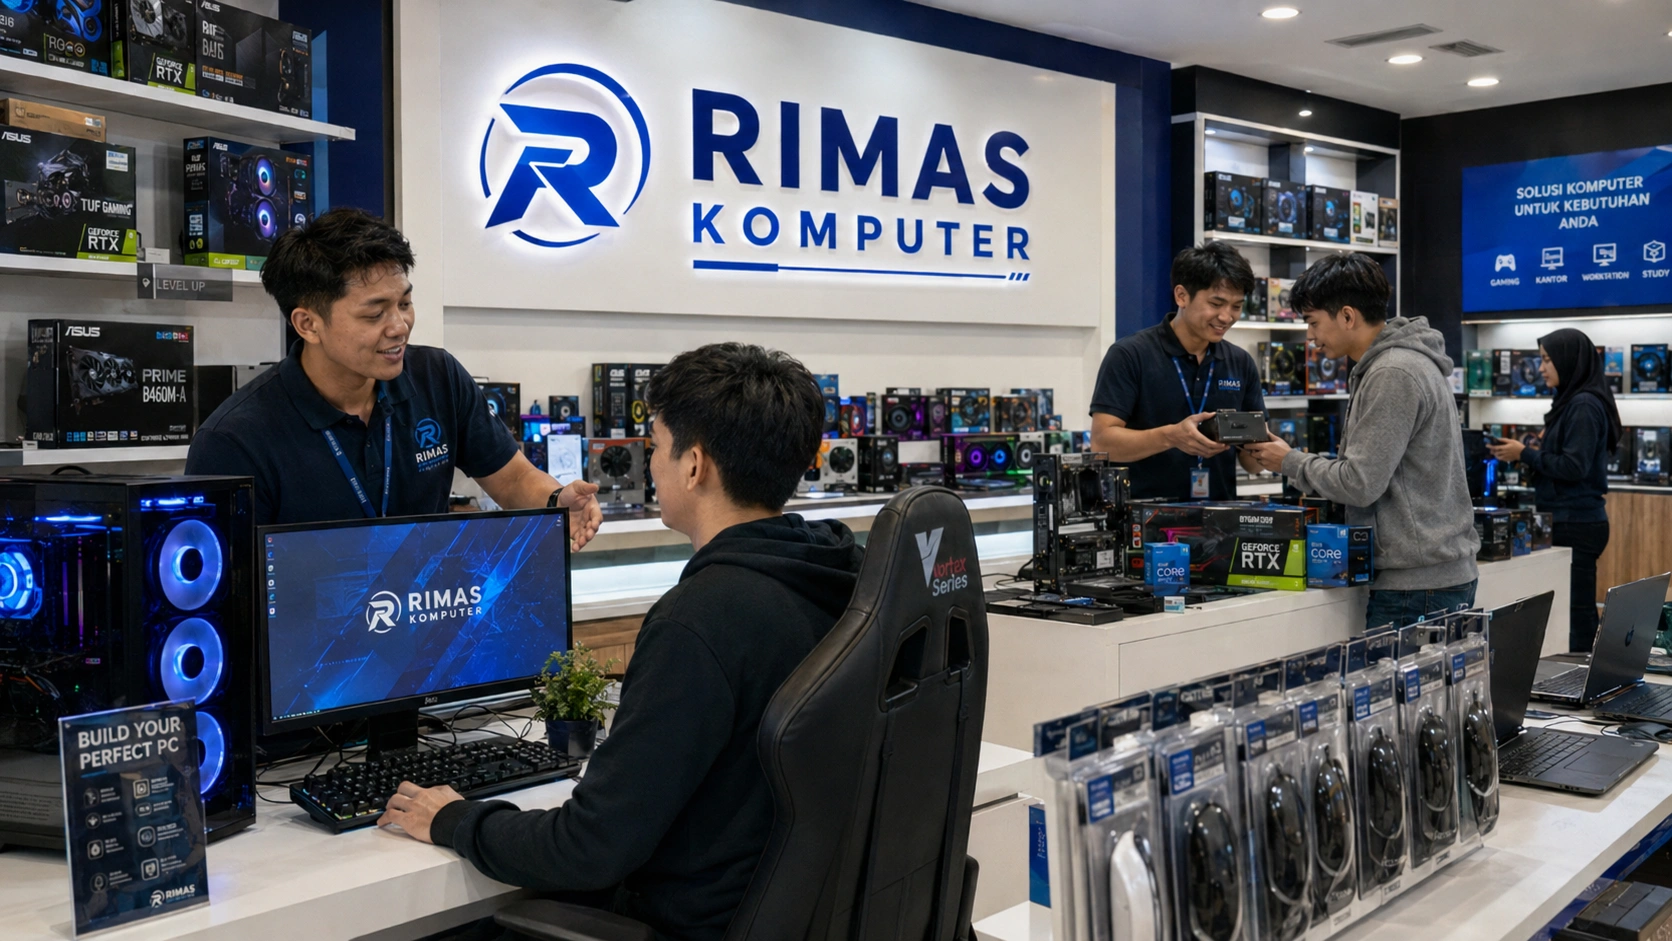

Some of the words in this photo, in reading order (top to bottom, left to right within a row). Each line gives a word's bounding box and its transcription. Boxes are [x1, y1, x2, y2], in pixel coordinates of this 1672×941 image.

[156, 66, 182, 84] RTX
[1, 131, 31, 143] ASUS
[692, 88, 1031, 210] RIMAS
[1516, 183, 1563, 200] SOLUSI
[1566, 175, 1643, 195] KOMPUTER
[81, 198, 101, 212] TUF
[1514, 201, 1560, 216] UNTUK
[1564, 192, 1650, 212] KEBUTUHAN
[693, 202, 1030, 260] KOMPUTER
[1558, 215, 1599, 230] ANDA
[88, 236, 119, 251] RTX
[1535, 274, 1568, 284] KANTOR
[1642, 269, 1670, 278] STUDY
[157, 280, 189, 291] LEVEL
[191, 281, 205, 292] UP
[65, 326, 100, 337] ASUS
[142, 369, 186, 382] PRIME
[142, 386, 186, 402] B460M-A
[415, 443, 449, 463] RIMAS
[1241, 542, 1280, 553] GEFORCE
[1241, 552, 1281, 570] RTX
[932, 573, 968, 597] Series
[408, 586, 482, 612] RIMAS
[409, 606, 482, 624] KOMPUTER
[78, 725, 130, 749] BUILD
[134, 716, 181, 738] YOUR
[80, 741, 153, 770] PERFECT
[157, 737, 179, 755] PC
[165, 884, 196, 899] RIMAS
